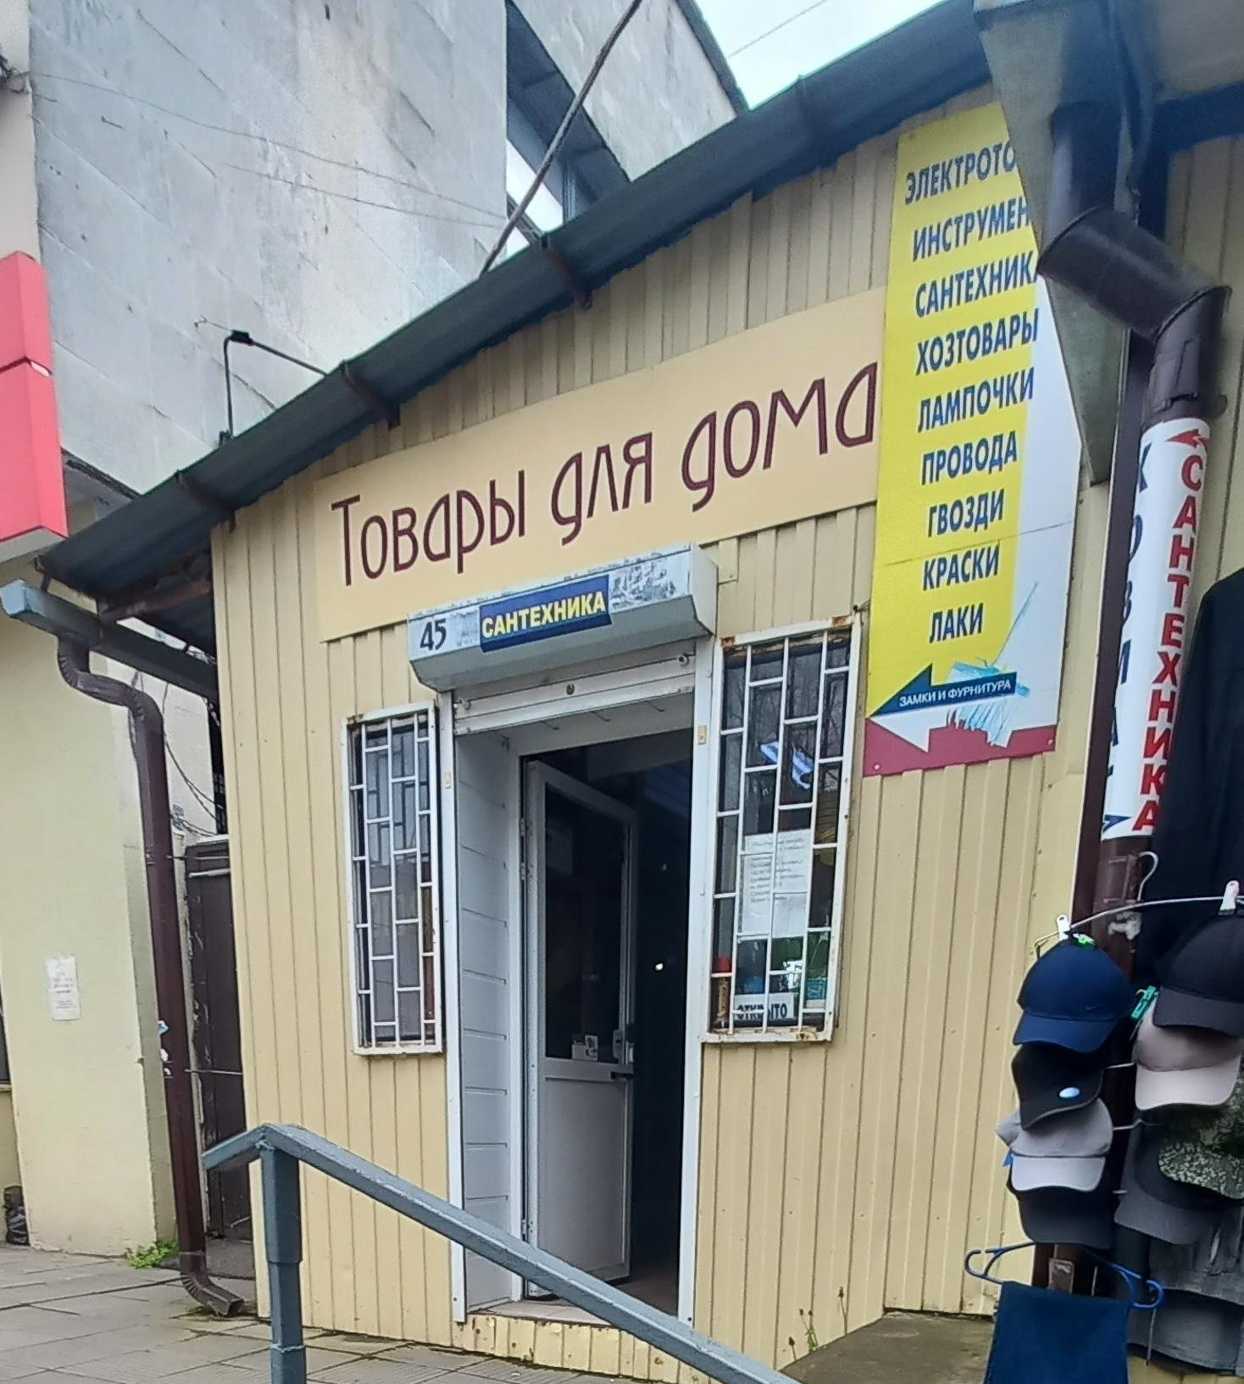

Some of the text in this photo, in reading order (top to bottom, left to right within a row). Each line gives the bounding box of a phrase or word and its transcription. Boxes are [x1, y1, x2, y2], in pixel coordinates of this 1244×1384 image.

[915, 308, 1039, 377] ХОЗТОВАРЫ
[918, 367, 1033, 432] ЛАМПОЧКИ
[330, 361, 878, 587] Товары для дома
[921, 430, 1018, 486] ПРОВОДА
[927, 488, 1005, 538] ГВОЗДИ
[922, 543, 1000, 591] КРАСКИ
[419, 591, 606, 651] 45 САНТЕХНИКА
[929, 602, 984, 644] ЛАКИ
[1132, 455, 1205, 832] САНТЕХНИКА
[899, 679, 1012, 707] ЗАМКИ И ФУРНИТУРА
